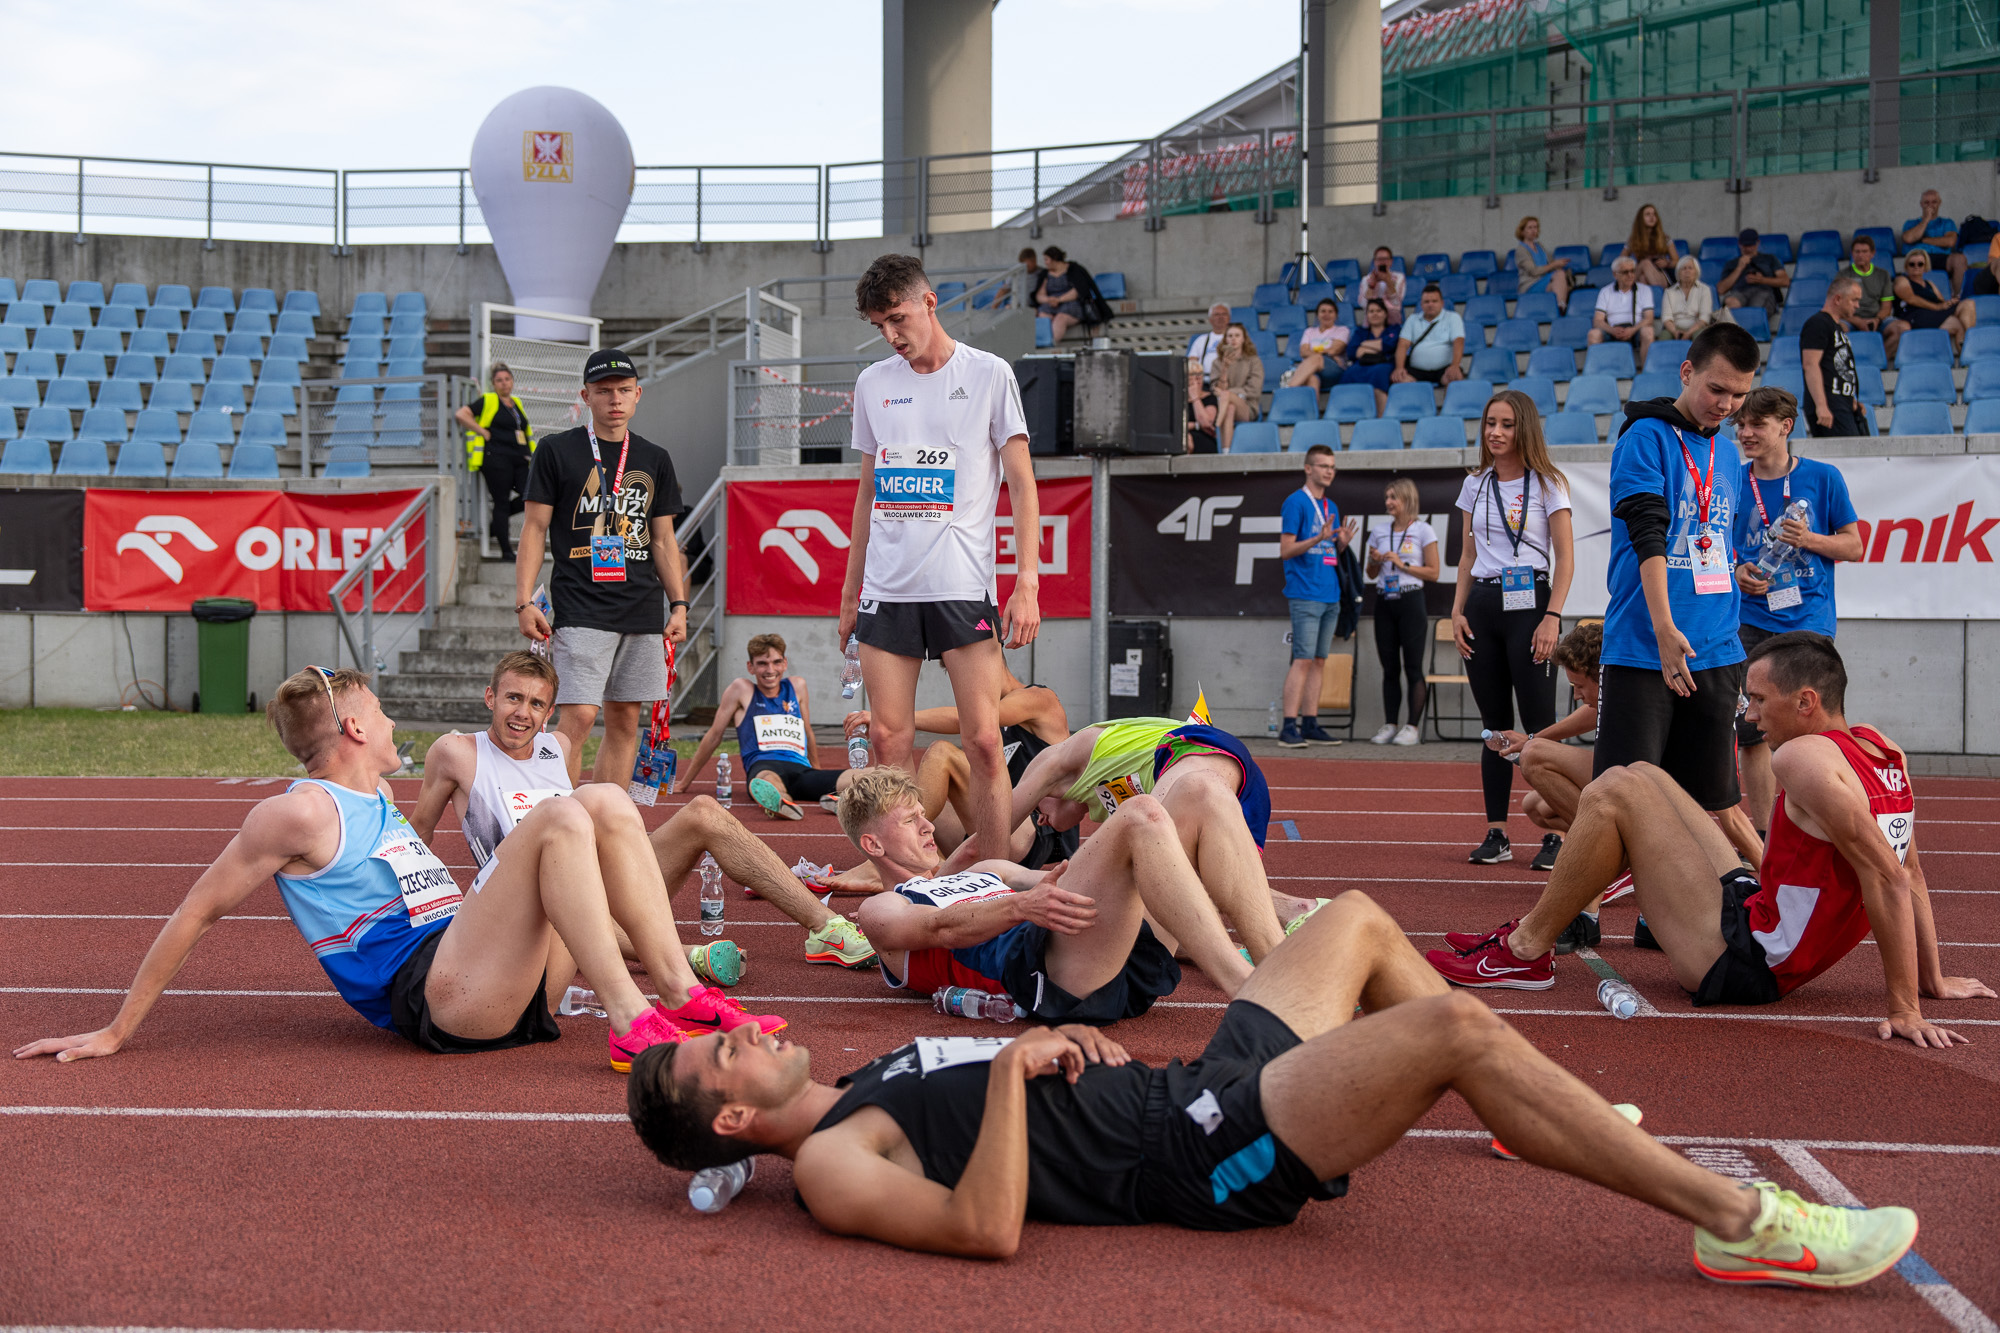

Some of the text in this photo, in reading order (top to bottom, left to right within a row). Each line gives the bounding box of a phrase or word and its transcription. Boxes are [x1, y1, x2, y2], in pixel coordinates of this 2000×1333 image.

[527, 165, 569, 179] PZLA
[916, 449, 949, 465] 269
[880, 476, 944, 495] MEGIER
[924, 511, 942, 519] 2023
[1157, 495, 1244, 542] 4F
[235, 525, 407, 571] ORLEN
[624, 548, 649, 561] 2023
[784, 716, 800, 726] 194
[761, 728, 802, 741] ANTOSZ
[513, 803, 534, 811] ORLEN
